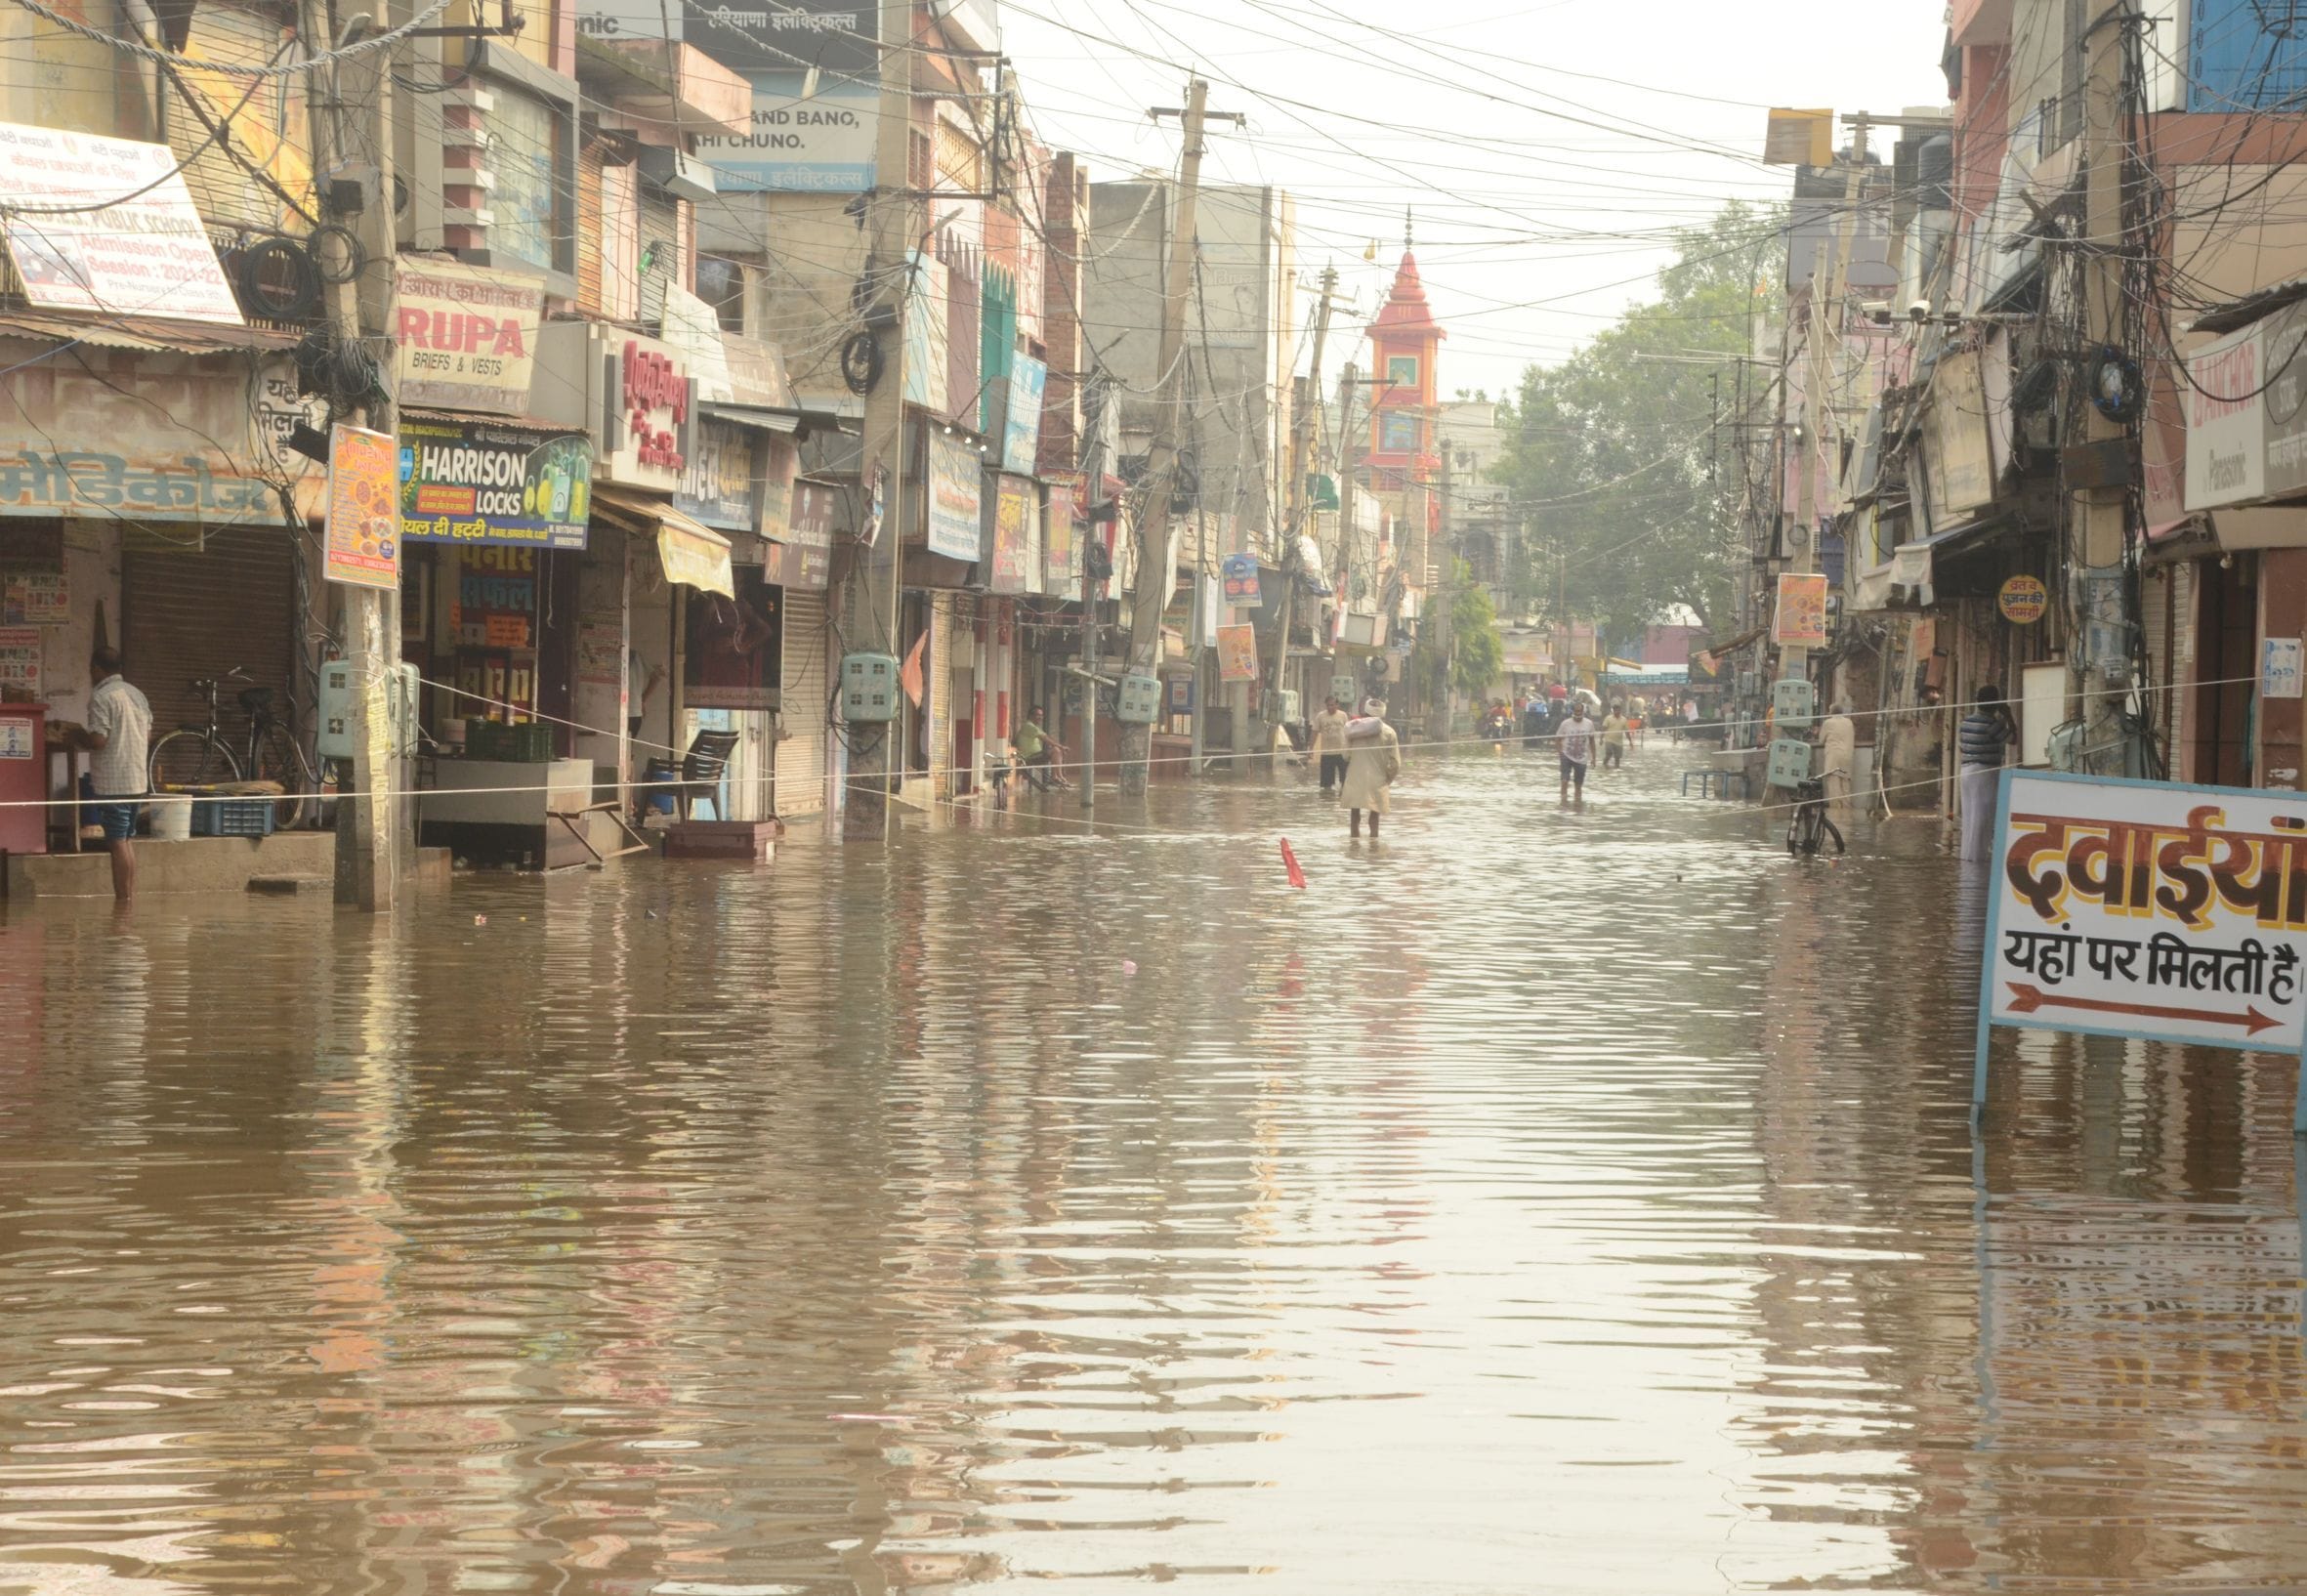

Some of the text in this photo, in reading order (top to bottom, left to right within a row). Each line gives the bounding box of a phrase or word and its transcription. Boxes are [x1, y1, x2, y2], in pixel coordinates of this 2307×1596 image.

[575, 11, 619, 35] nic
[728, 134, 806, 149] CHUNO.
[145, 213, 204, 240] SCHOOL
[81, 233, 213, 265] Admission Open
[398, 306, 524, 358] RUPA
[412, 352, 503, 376] BRIEFS & VESTS
[2203, 342, 2256, 422] ANCHOR
[421, 444, 527, 488] HARRISON
[476, 489, 522, 517] LOCKS
[433, 515, 450, 536] दी
[2003, 921, 2082, 986] यहां
[2086, 937, 2142, 983] पर
[2147, 931, 2269, 995] मिलती
